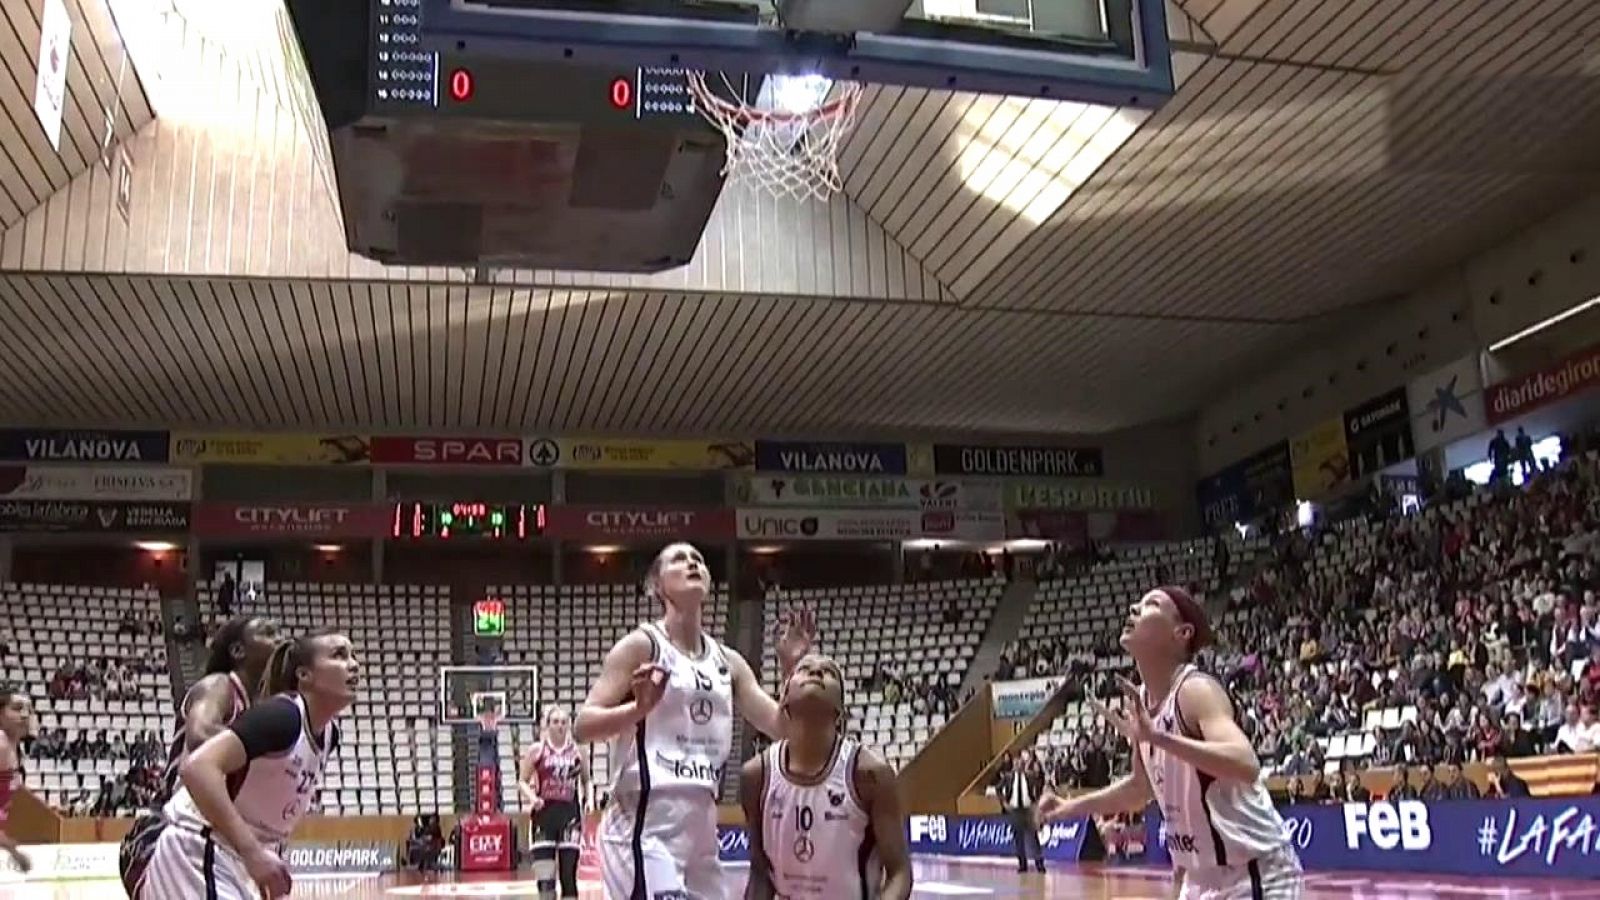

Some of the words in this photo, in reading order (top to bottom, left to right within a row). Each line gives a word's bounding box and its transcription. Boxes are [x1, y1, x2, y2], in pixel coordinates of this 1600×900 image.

[453, 70, 469, 98] 0
[613, 79, 630, 106] 0
[25, 439, 142, 460] VILANOVA
[413, 440, 520, 462] SPAR
[779, 452, 884, 471] VILANOVA
[234, 506, 350, 523] CITYLIFT
[586, 510, 696, 526] CITYLIFT
[796, 805, 813, 831] 10
[1476, 806, 1600, 865] #LAFA
